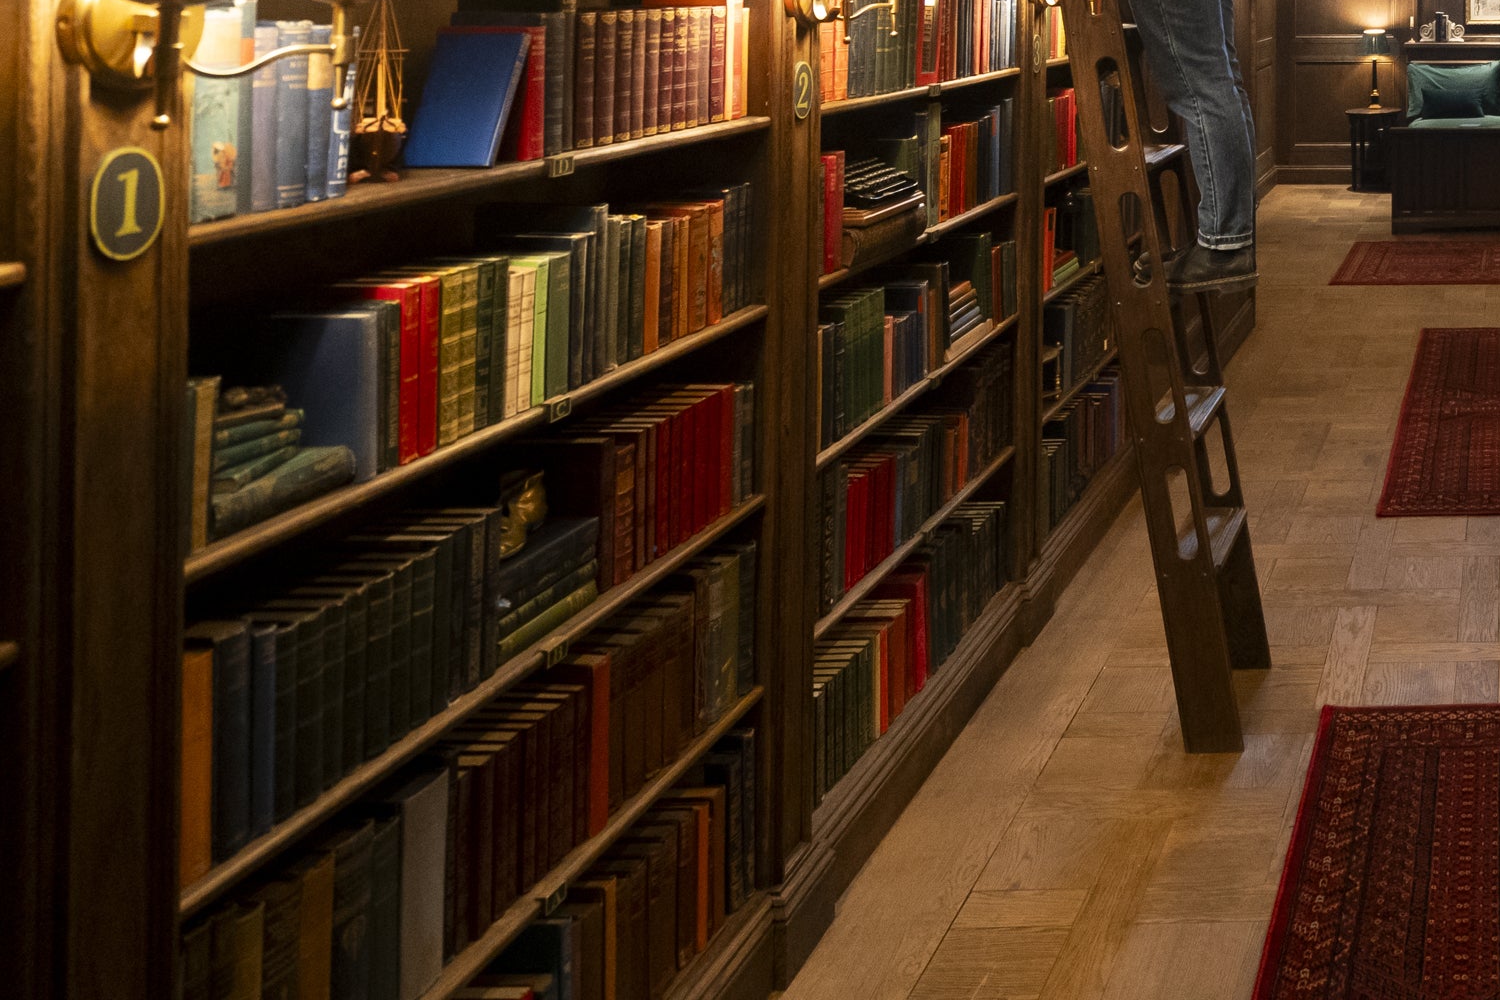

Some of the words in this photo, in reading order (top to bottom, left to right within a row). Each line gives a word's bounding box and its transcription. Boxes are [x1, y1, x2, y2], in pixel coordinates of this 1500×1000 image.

[1034, 40, 1040, 65] 3
[796, 72, 809, 109] 2
[559, 159, 569, 171] D
[115, 167, 143, 238] 1
[556, 400, 568, 417] C
